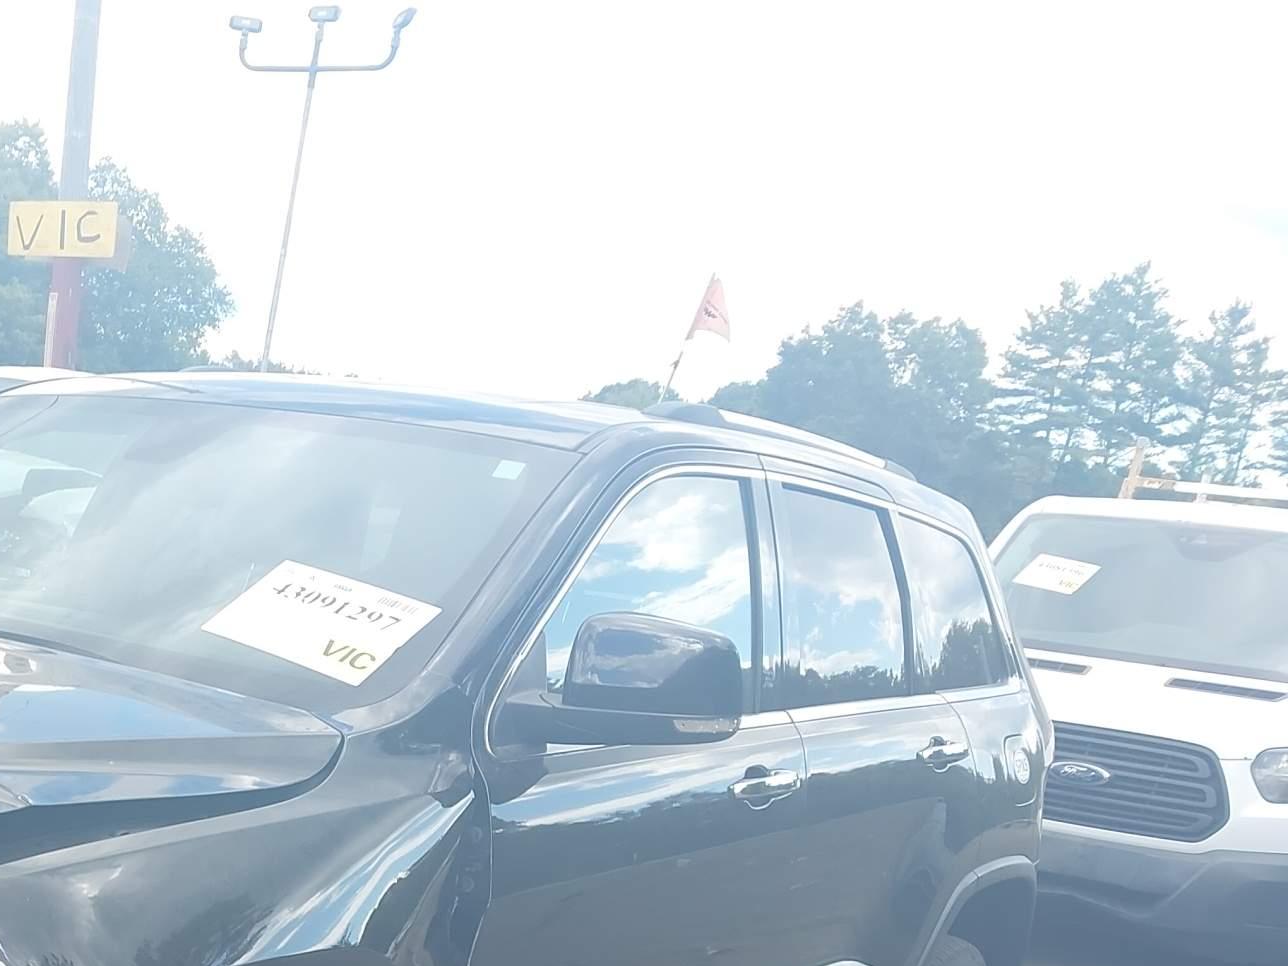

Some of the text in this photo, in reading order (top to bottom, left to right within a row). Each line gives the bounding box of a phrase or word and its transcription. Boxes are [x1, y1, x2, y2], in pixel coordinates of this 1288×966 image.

[15, 208, 101, 251] VIC
[272, 582, 402, 631] 43091297
[321, 639, 377, 670] VIC
